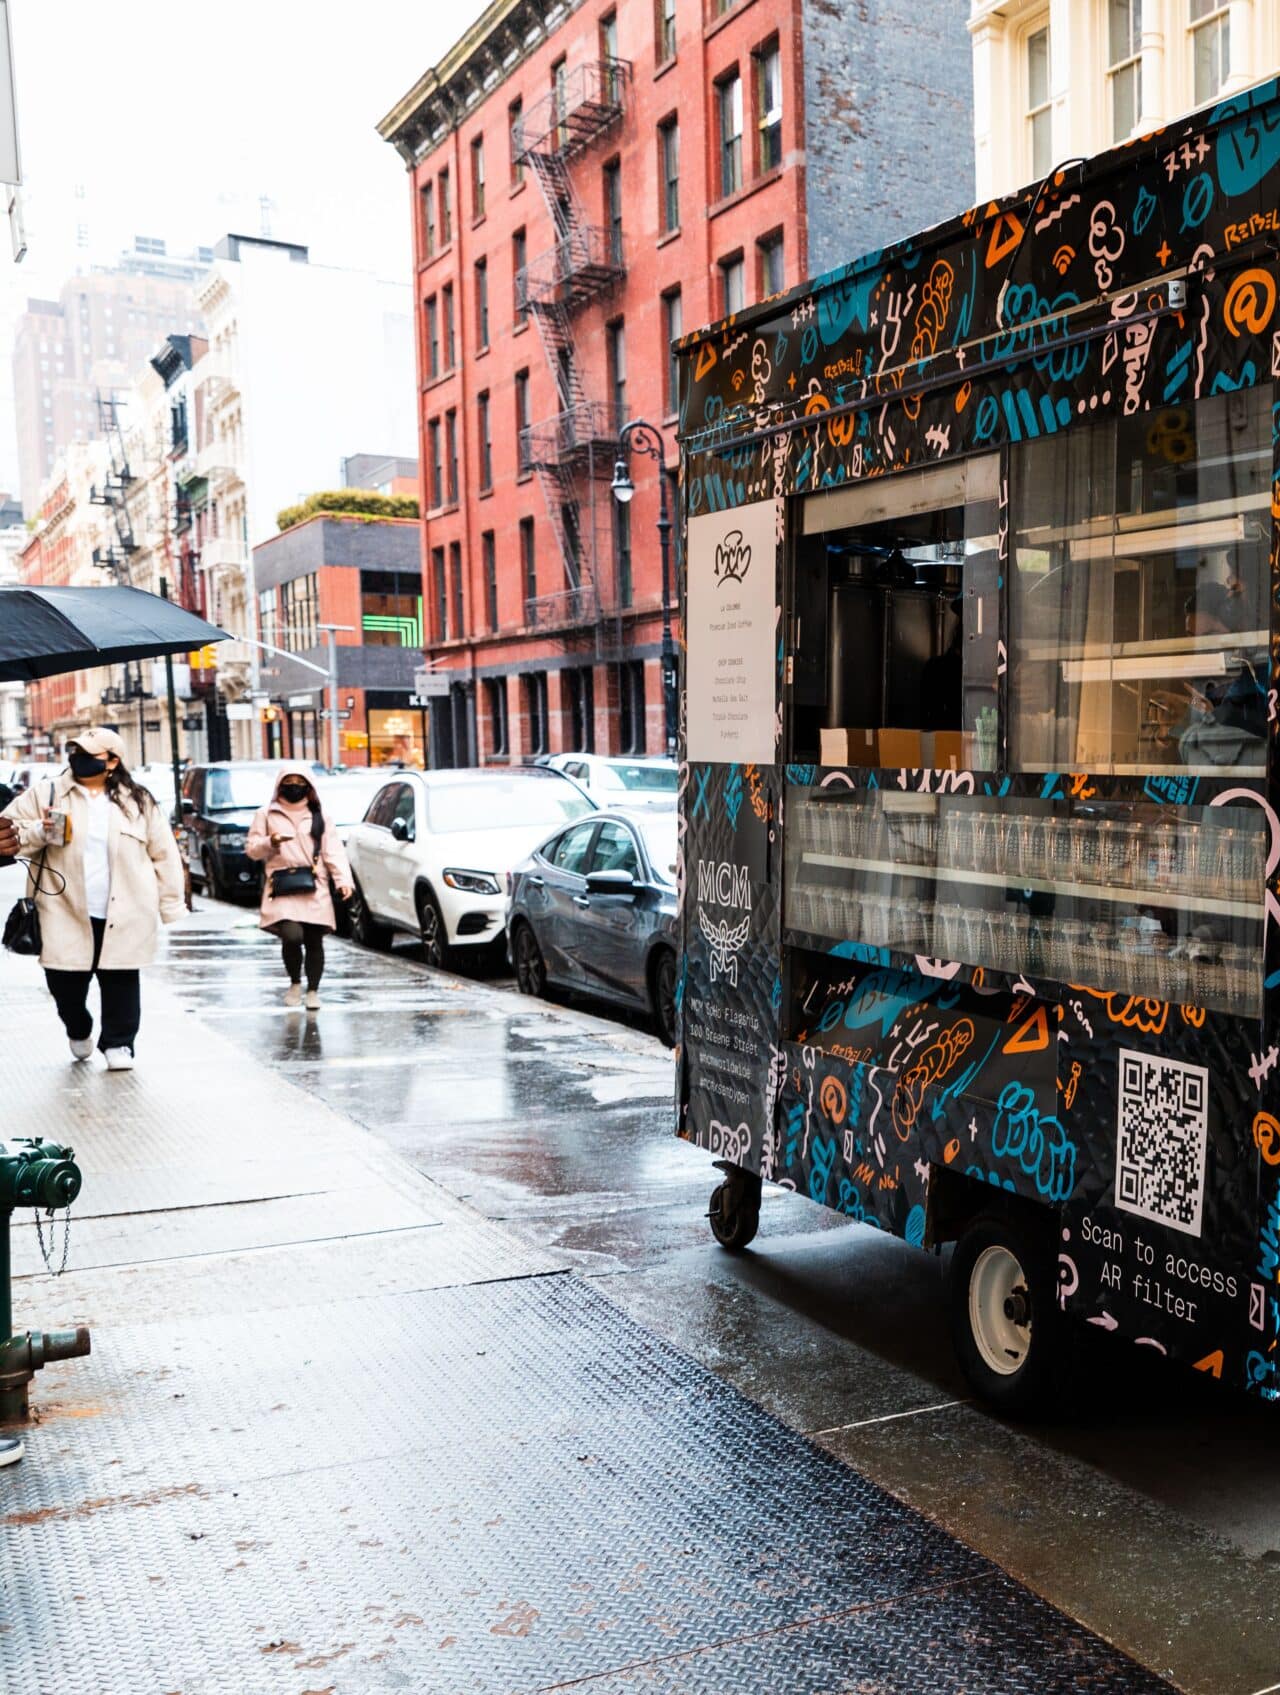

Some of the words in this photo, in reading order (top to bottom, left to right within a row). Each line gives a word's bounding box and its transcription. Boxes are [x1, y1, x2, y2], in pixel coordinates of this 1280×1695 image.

[697, 859, 752, 910] MCM
[708, 1119, 752, 1168] DROP
[1081, 1216, 1123, 1253] Scan
[1133, 1236, 1155, 1266] to
[1165, 1253, 1238, 1297] access
[1100, 1261, 1122, 1291] AR
[1132, 1274, 1198, 1324] filter
